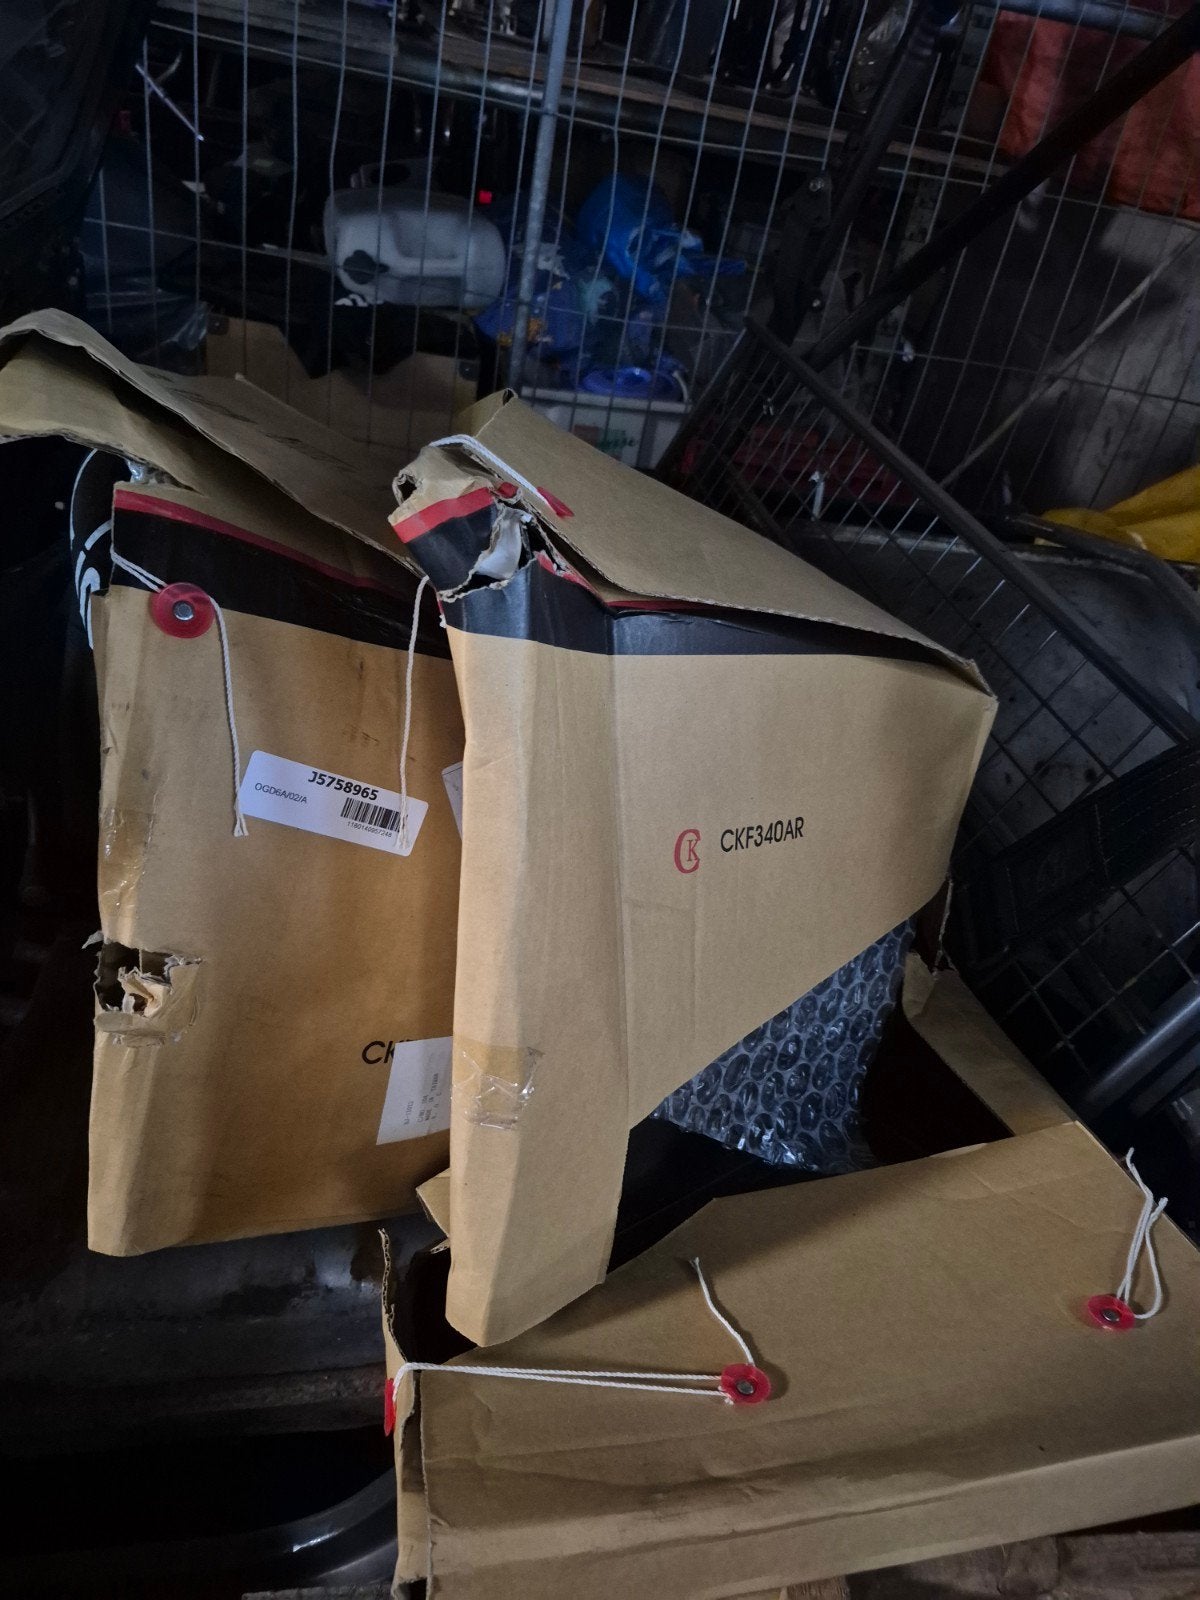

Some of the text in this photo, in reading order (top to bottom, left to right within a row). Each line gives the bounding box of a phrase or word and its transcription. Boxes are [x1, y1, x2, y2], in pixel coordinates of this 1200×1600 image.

[254, 782, 308, 804] OGD6A/02/A
[307, 770, 380, 801] J5758965
[720, 816, 805, 853] CKF340AR
[361, 1039, 405, 1065] CK
